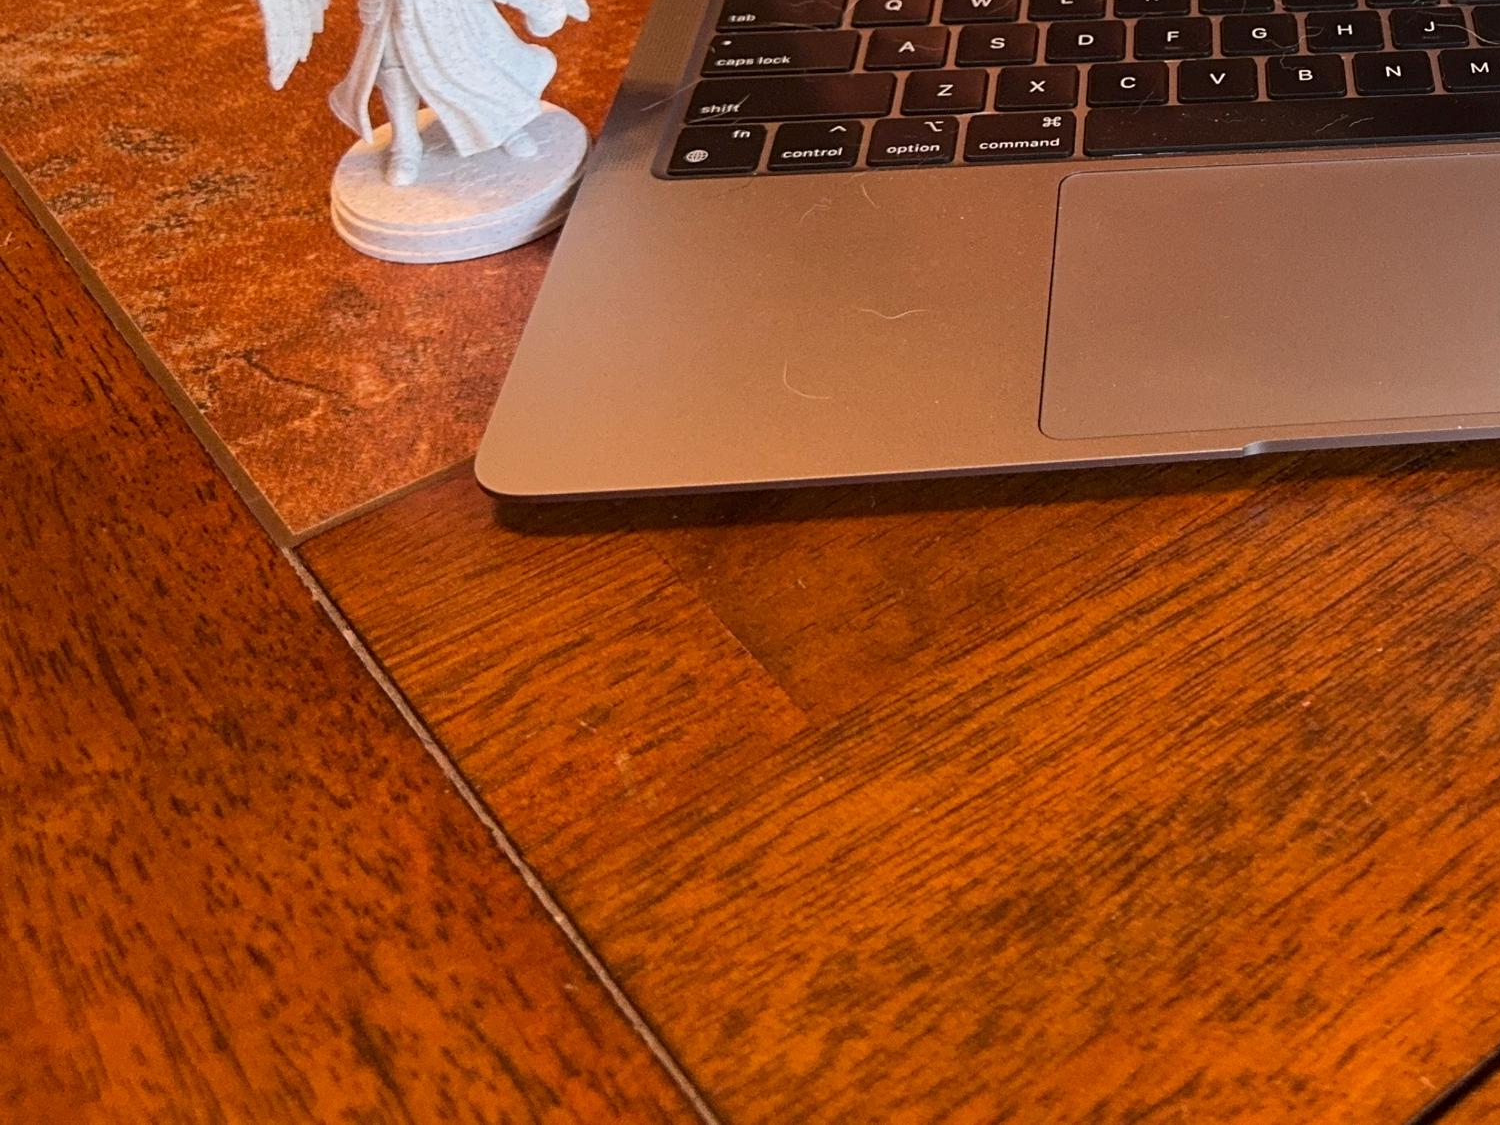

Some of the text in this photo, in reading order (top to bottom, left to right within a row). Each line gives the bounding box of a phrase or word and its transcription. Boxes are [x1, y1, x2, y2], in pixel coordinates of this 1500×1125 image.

[885, 0, 902, 11] Q
[730, 14, 755, 22] tab
[1338, 25, 1352, 35] H
[1424, 21, 1434, 31] J
[1167, 31, 1179, 42] F
[1252, 28, 1267, 38] G
[991, 38, 1004, 48] S
[1078, 35, 1093, 45] D
[899, 41, 915, 52] A
[758, 56, 790, 64] lock
[1386, 66, 1401, 77] N
[1471, 62, 1489, 73] M
[1210, 73, 1225, 84] V
[1299, 70, 1312, 80] B
[1030, 81, 1045, 92] X
[1121, 77, 1135, 88] C
[937, 85, 953, 96] Z
[701, 104, 740, 114] shift
[734, 130, 750, 138] fn
[979, 138, 1059, 149] command
[782, 147, 842, 158] control
[887, 144, 939, 154] option
